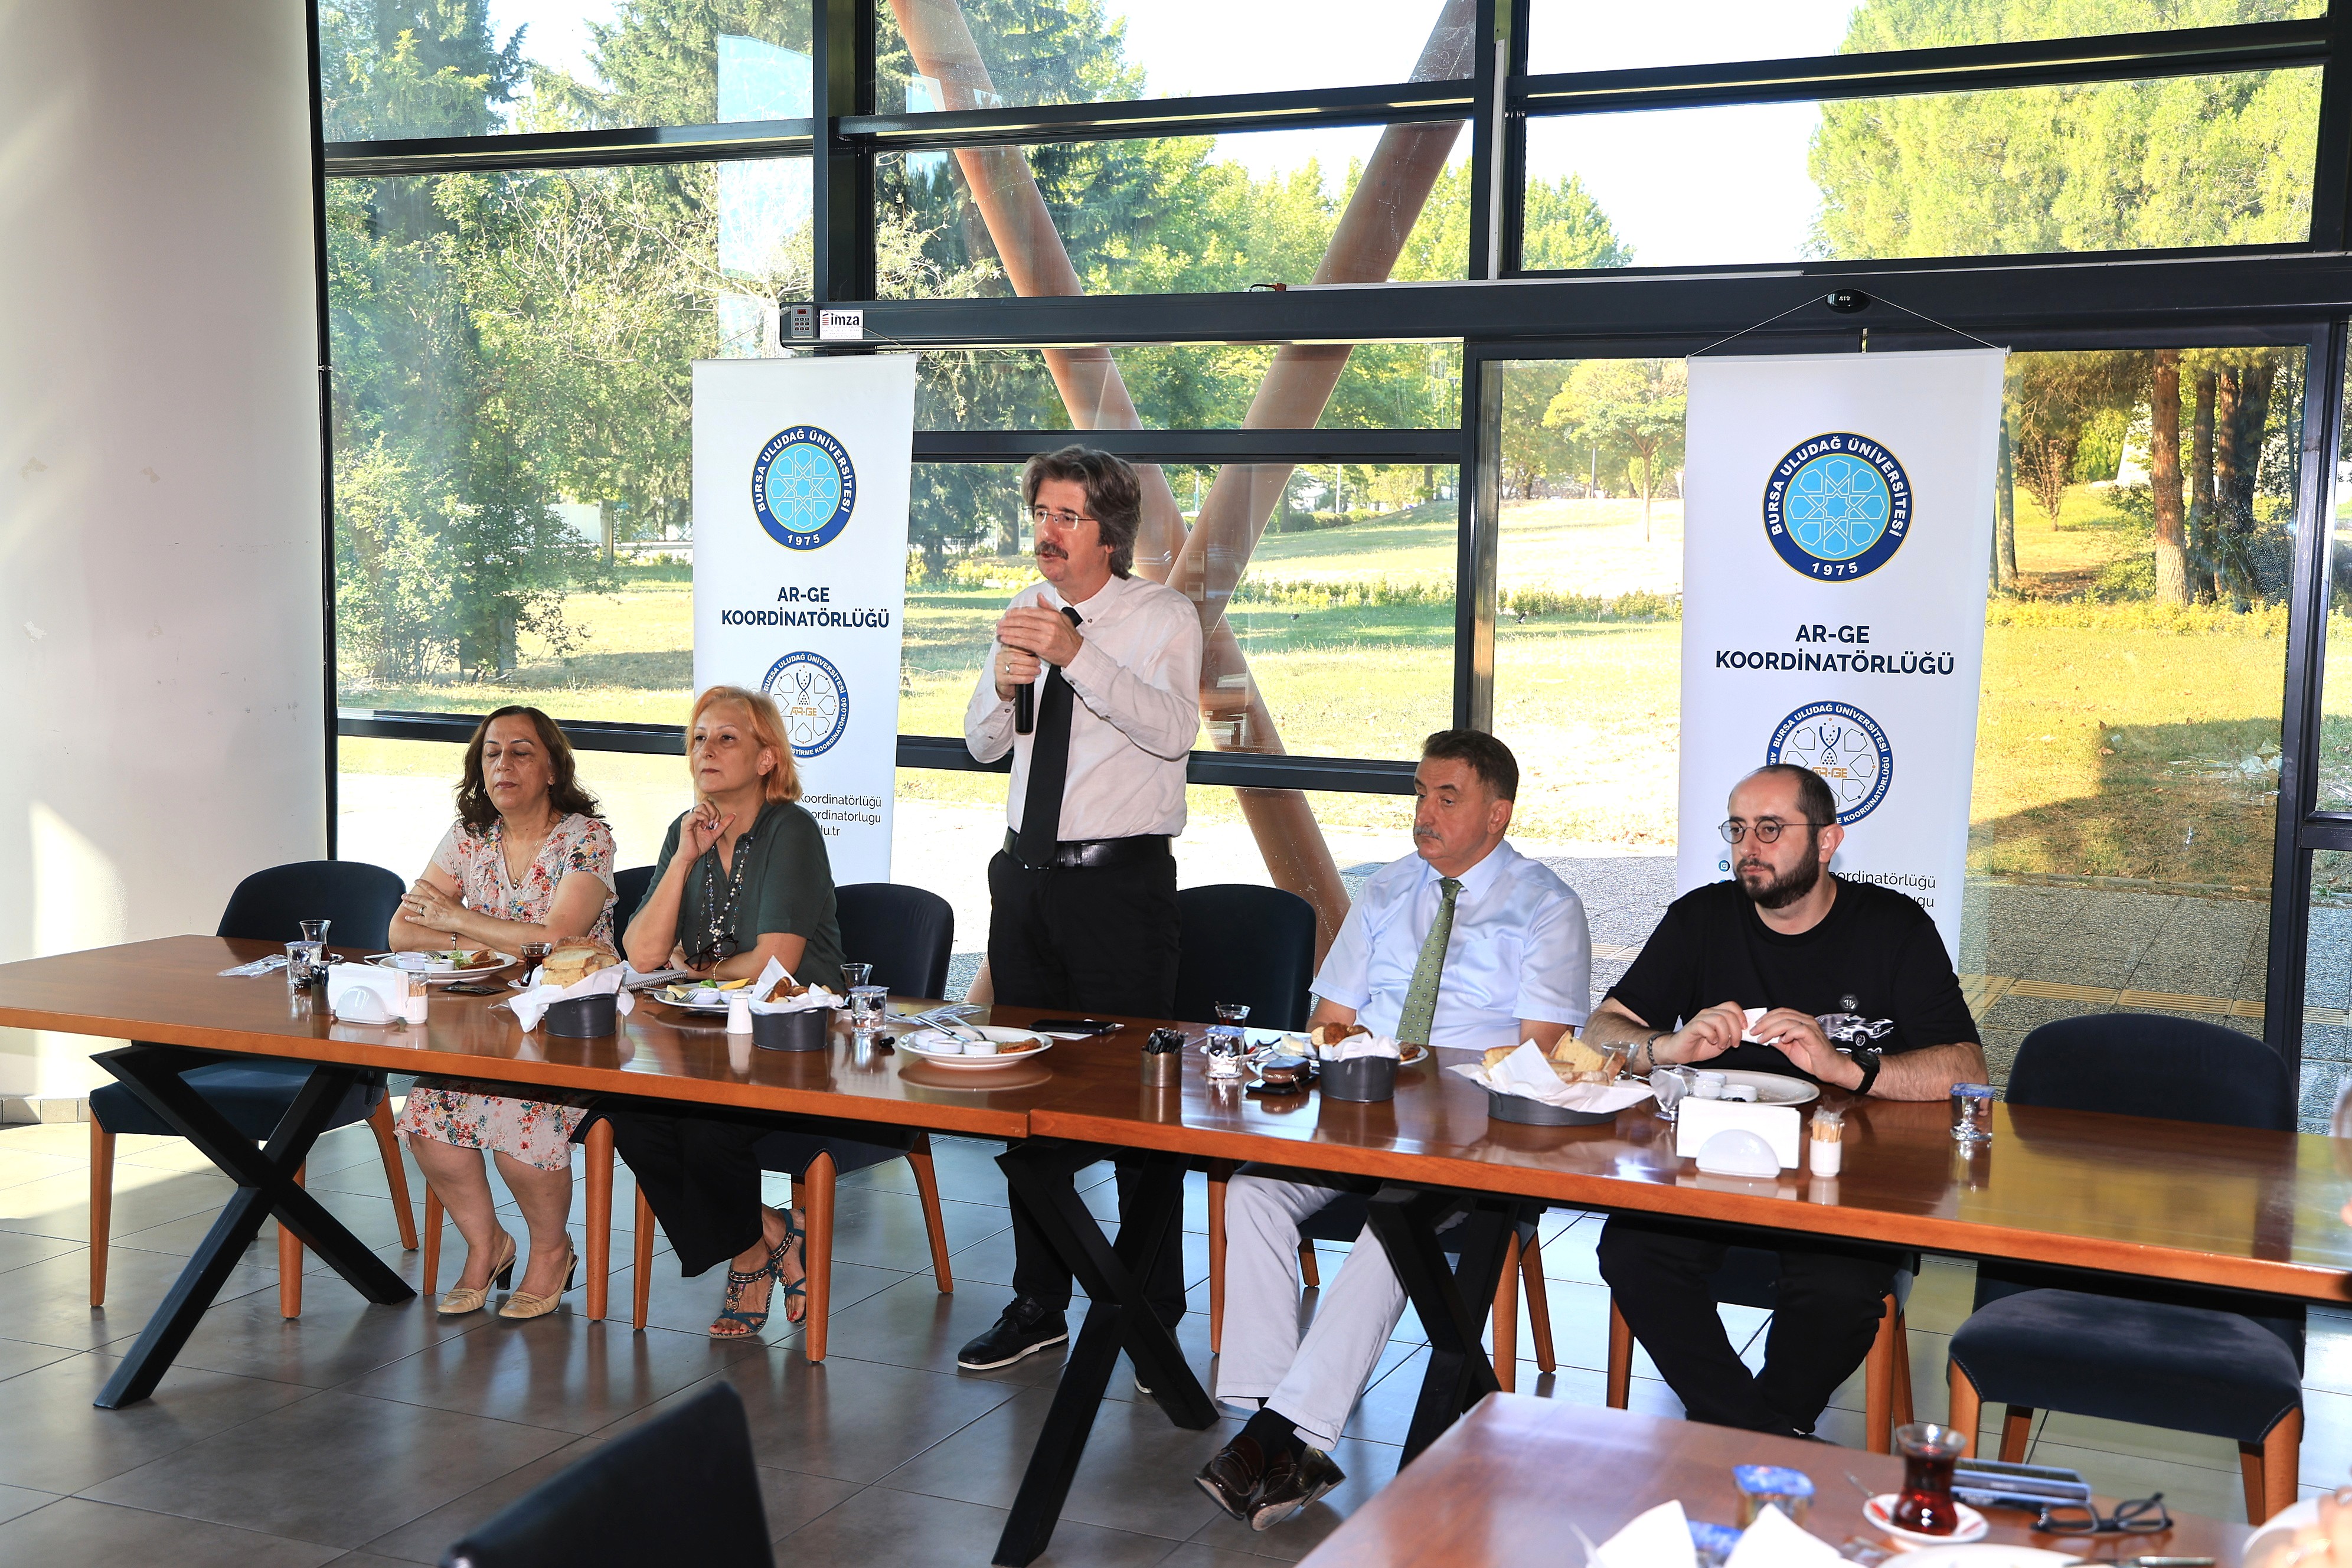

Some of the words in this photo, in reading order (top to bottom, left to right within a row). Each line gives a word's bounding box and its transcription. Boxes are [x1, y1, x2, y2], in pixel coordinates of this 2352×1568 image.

[831, 313, 860, 325] imza
[754, 466, 766, 512] BURSA
[762, 428, 805, 462] ULUDAĞ
[809, 429, 853, 513] ÜNİVERSİTESİ
[1768, 481, 1785, 536] BURSA
[1779, 436, 1841, 476] ULUDAĞ
[1847, 437, 1908, 538] ÜNİVERSİTESİ
[787, 534, 820, 545] 1975
[1812, 562, 1858, 576] 1975
[777, 586, 830, 603] AR-GE
[721, 607, 890, 628] KOORDİNATÖRLÜĞÜ
[1795, 624, 1870, 644] AR-GE
[763, 668, 779, 692] BURSA
[778, 652, 806, 668] ULUDAĞ
[807, 653, 847, 694] ÜNİVERSİTESİ
[1715, 648, 1955, 675] KOORDİNATÖRLÜĞÜ
[814, 697, 847, 754] KOORDİNATÖRLÜĞÜ
[1772, 719, 1796, 749] BURSA
[1794, 703, 1833, 721] ULUDAĞ
[1835, 704, 1890, 753] ÜNİVERSİTESİ
[1843, 756, 1890, 822] KOORDİNATÖRLÜĞÜ
[1829, 870, 1936, 890] ordinatörlüğü
